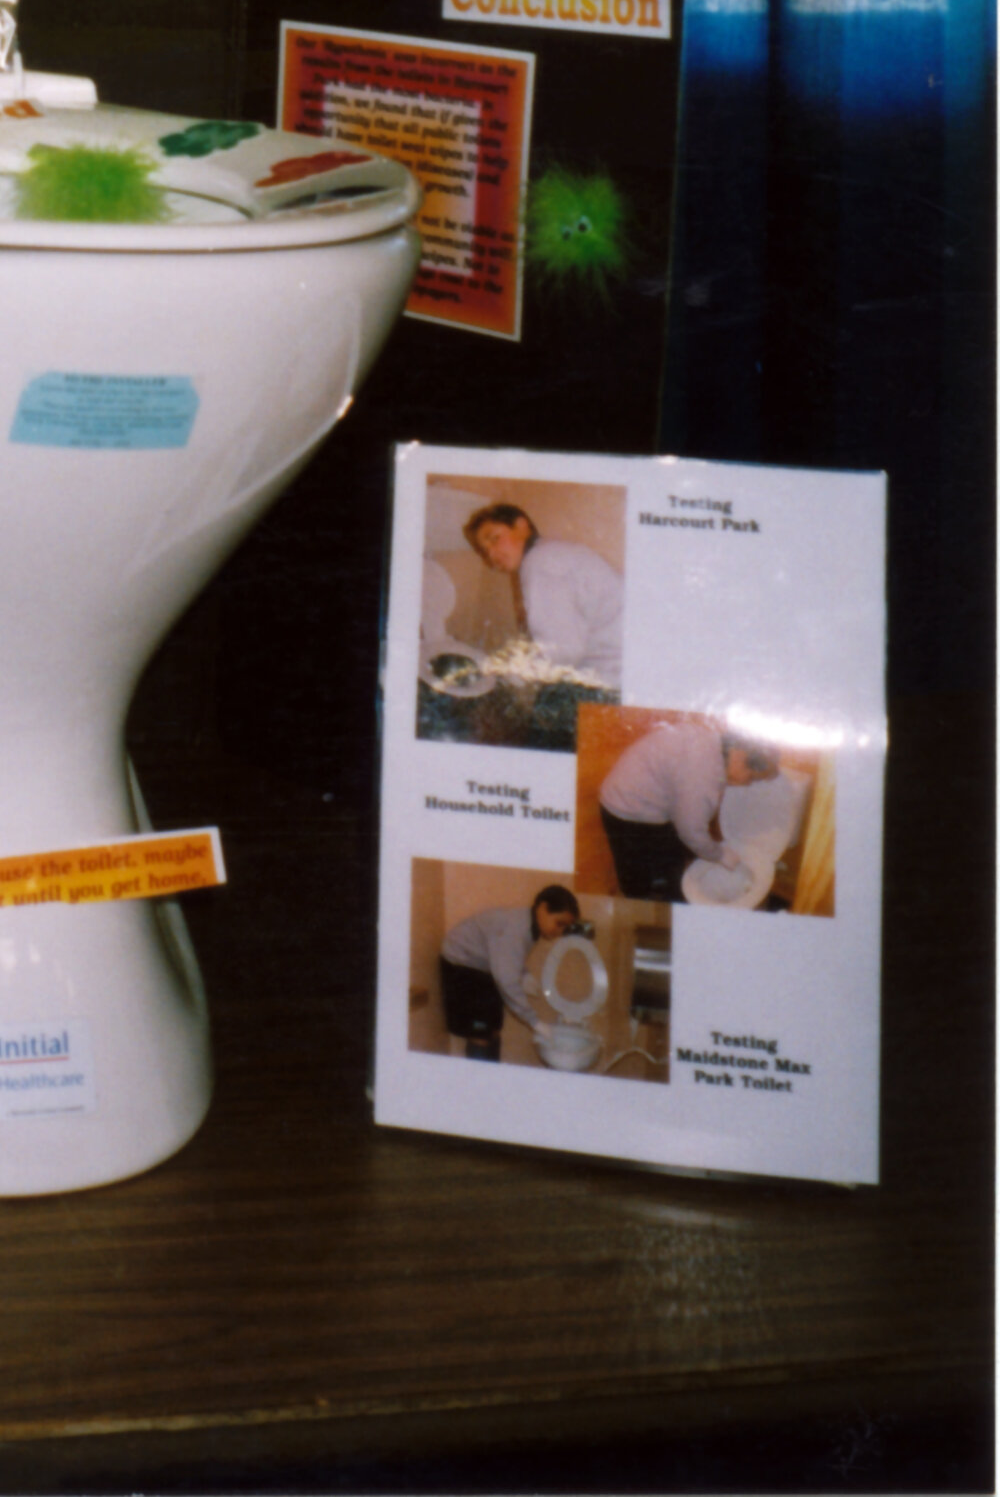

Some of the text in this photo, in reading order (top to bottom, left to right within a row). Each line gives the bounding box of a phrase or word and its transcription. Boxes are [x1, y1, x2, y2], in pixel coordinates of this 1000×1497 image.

[639, 511, 760, 533] Harcourt Park
[466, 780, 531, 802] Testing
[425, 795, 570, 822] Household Toilet
[41, 858, 73, 878] the
[144, 843, 207, 866] maybe
[13, 885, 62, 906] until
[68, 886, 105, 905] you
[110, 879, 141, 898] get
[710, 1031, 778, 1055] Testing
[677, 1047, 811, 1075] Maidstone Max
[694, 1069, 793, 1093] Park Toilet
